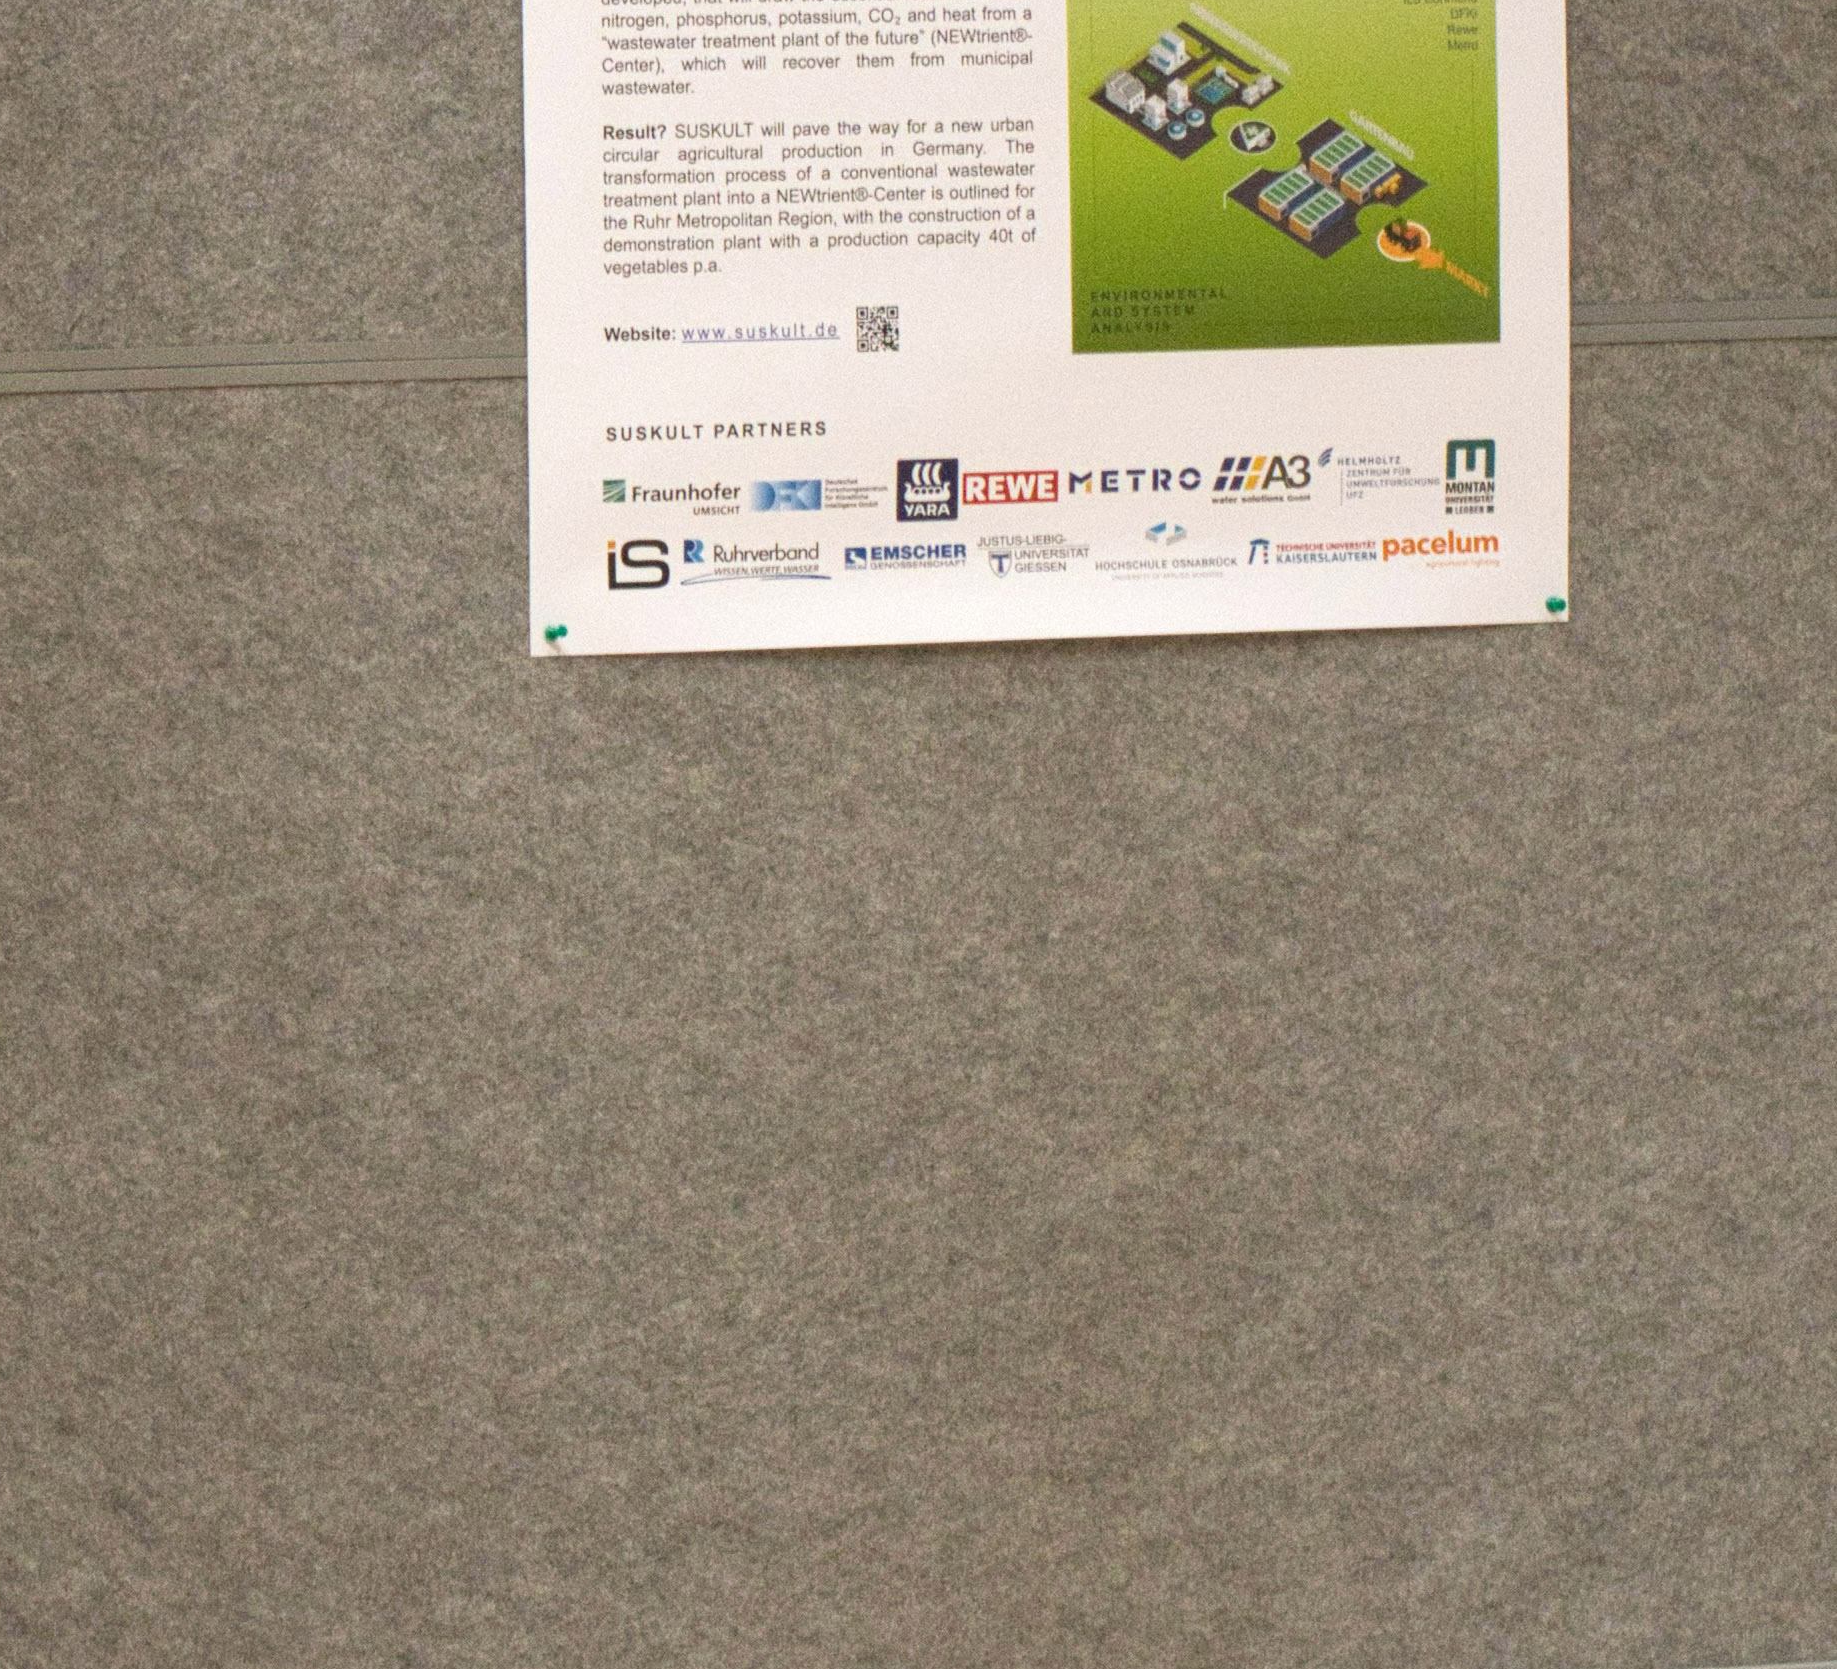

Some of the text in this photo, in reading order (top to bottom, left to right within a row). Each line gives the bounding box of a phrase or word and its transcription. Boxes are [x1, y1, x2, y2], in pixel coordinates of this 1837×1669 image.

[603, 326, 676, 342] Website:
[681, 321, 839, 343] www.suskult.de
[606, 420, 827, 443] SUSKULT PARTNERS
[1068, 467, 1202, 494] METRO
[1261, 455, 1311, 489] A3
[631, 483, 742, 503] Fraunhofer
[966, 473, 1058, 501] REWE
[1445, 481, 1496, 495] MONTAN
[692, 506, 741, 517] UMSICHT
[904, 503, 951, 518] YARA
[713, 542, 820, 563] Ruhrverband
[870, 544, 967, 561] EMSCHER
[1382, 531, 1499, 562] pacelum
[1094, 555, 1239, 572] HOCHSCHULE OSNABRÜCK
[1276, 550, 1377, 565] KAISERSLAUTERN
